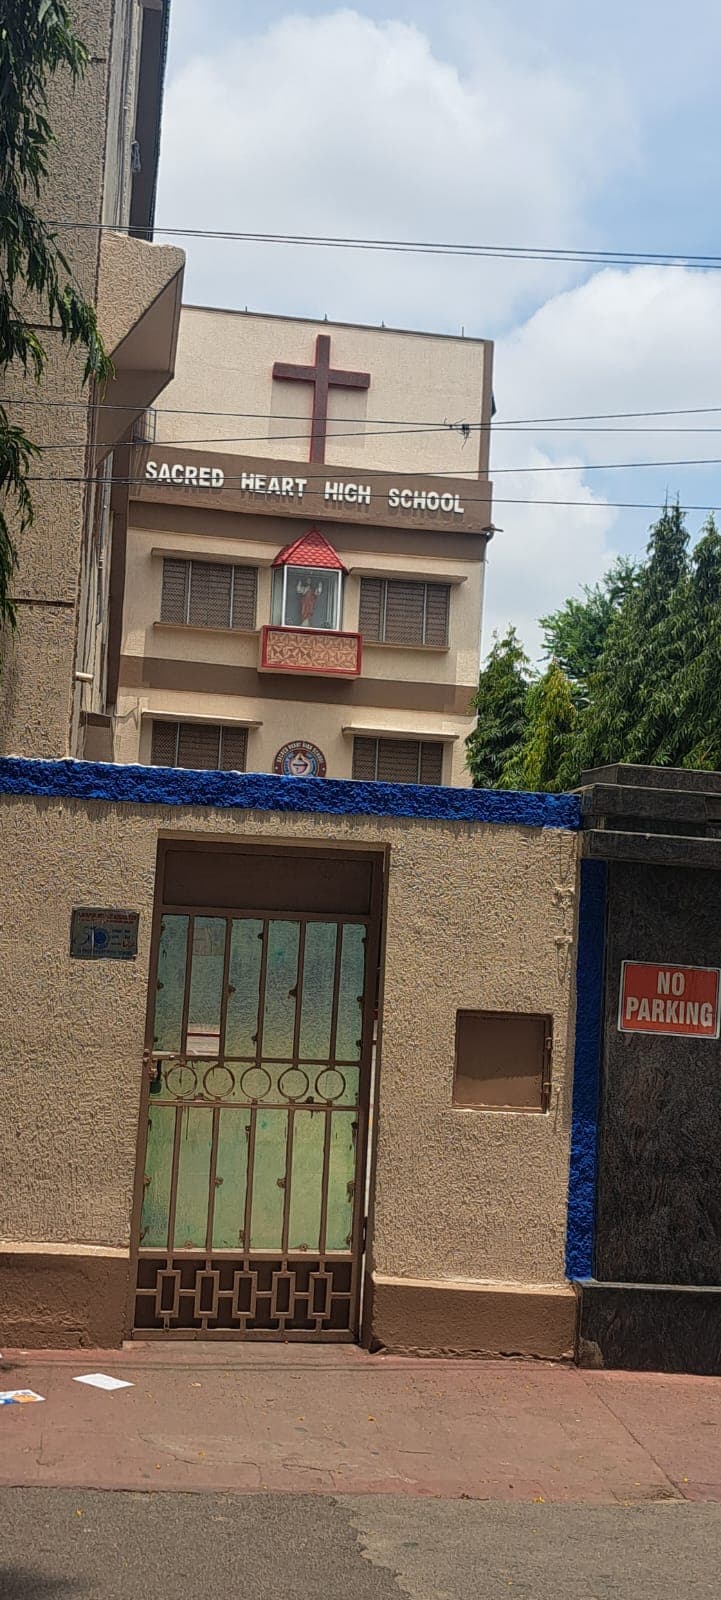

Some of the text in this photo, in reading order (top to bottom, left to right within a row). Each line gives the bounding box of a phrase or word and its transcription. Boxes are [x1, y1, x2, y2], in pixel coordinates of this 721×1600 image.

[145, 461, 465, 513] SACRED HEART HIGH SCHOOL
[657, 971, 685, 996] NO
[625, 997, 713, 1027] PARKING
